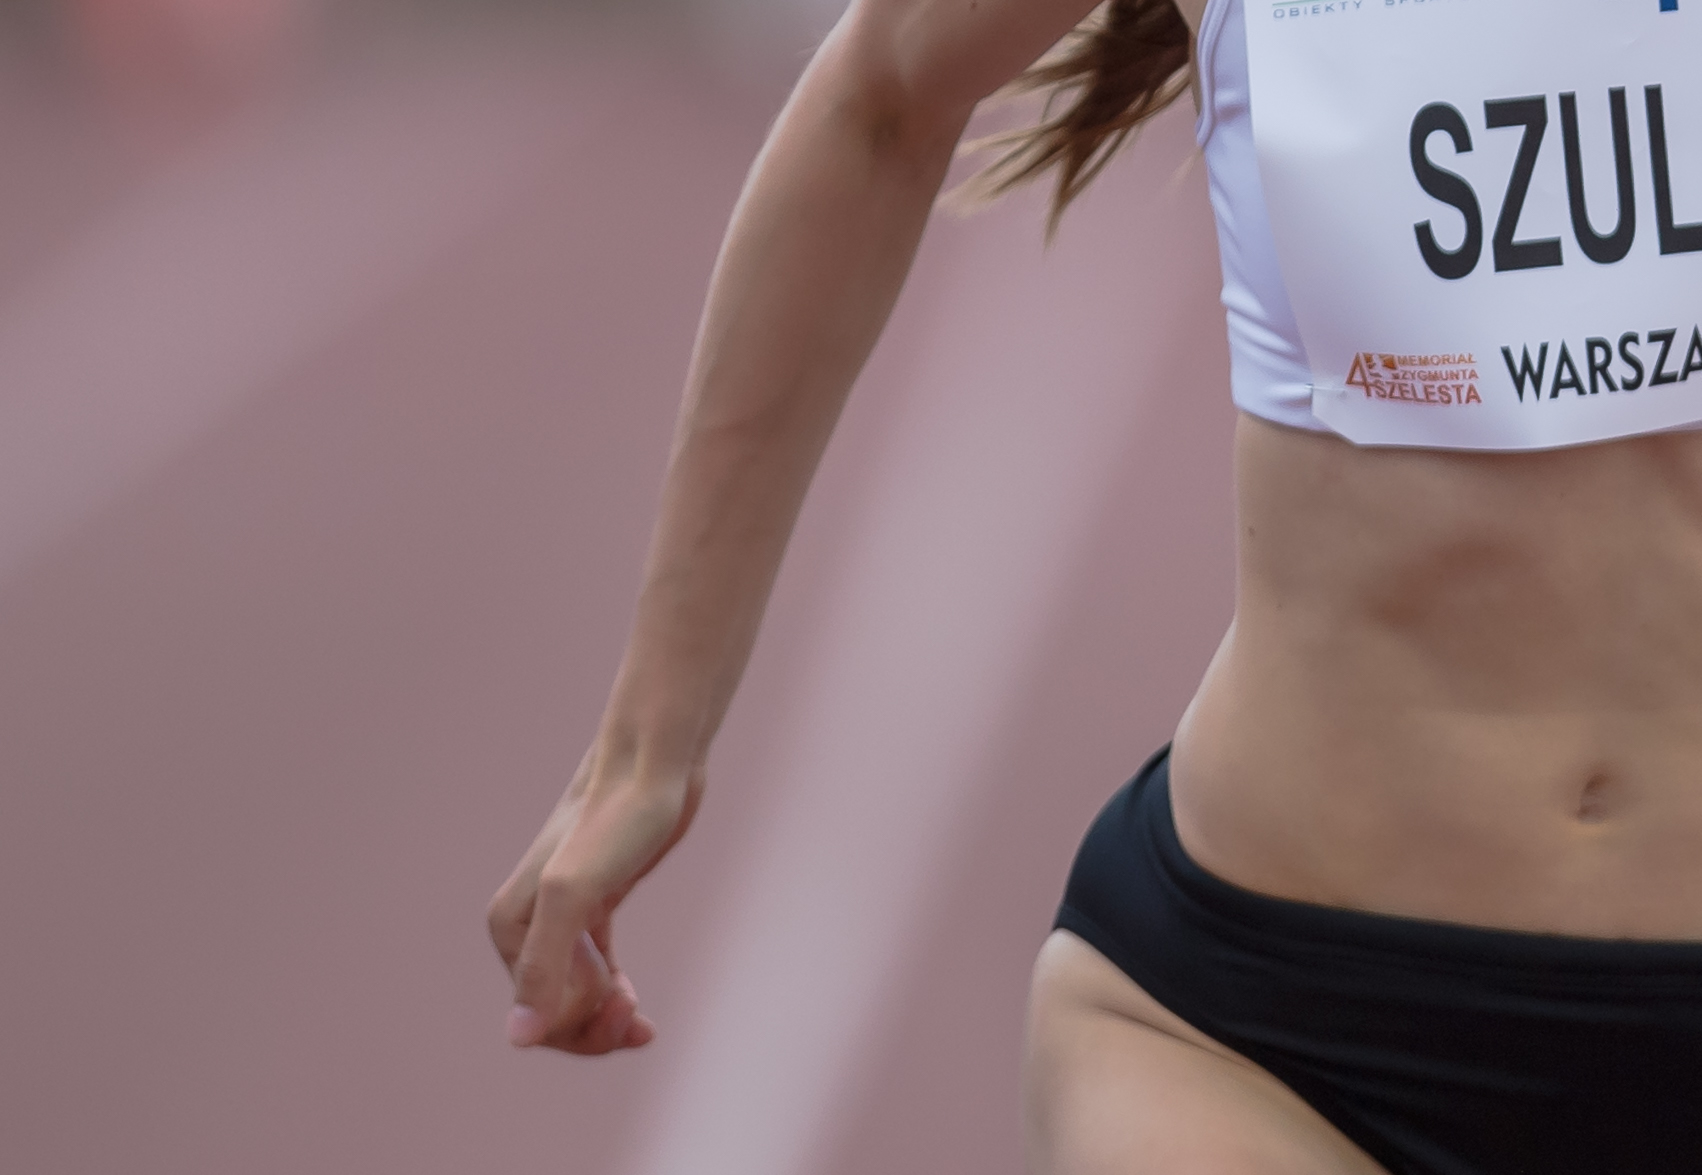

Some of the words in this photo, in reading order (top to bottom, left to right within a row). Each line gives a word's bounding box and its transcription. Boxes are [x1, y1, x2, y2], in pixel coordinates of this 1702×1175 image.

[1273, 0, 1364, 19] OBIEKTY
[1399, 368, 1479, 382] ZYGMUNTA
[1373, 379, 1482, 405] SZELESTA
